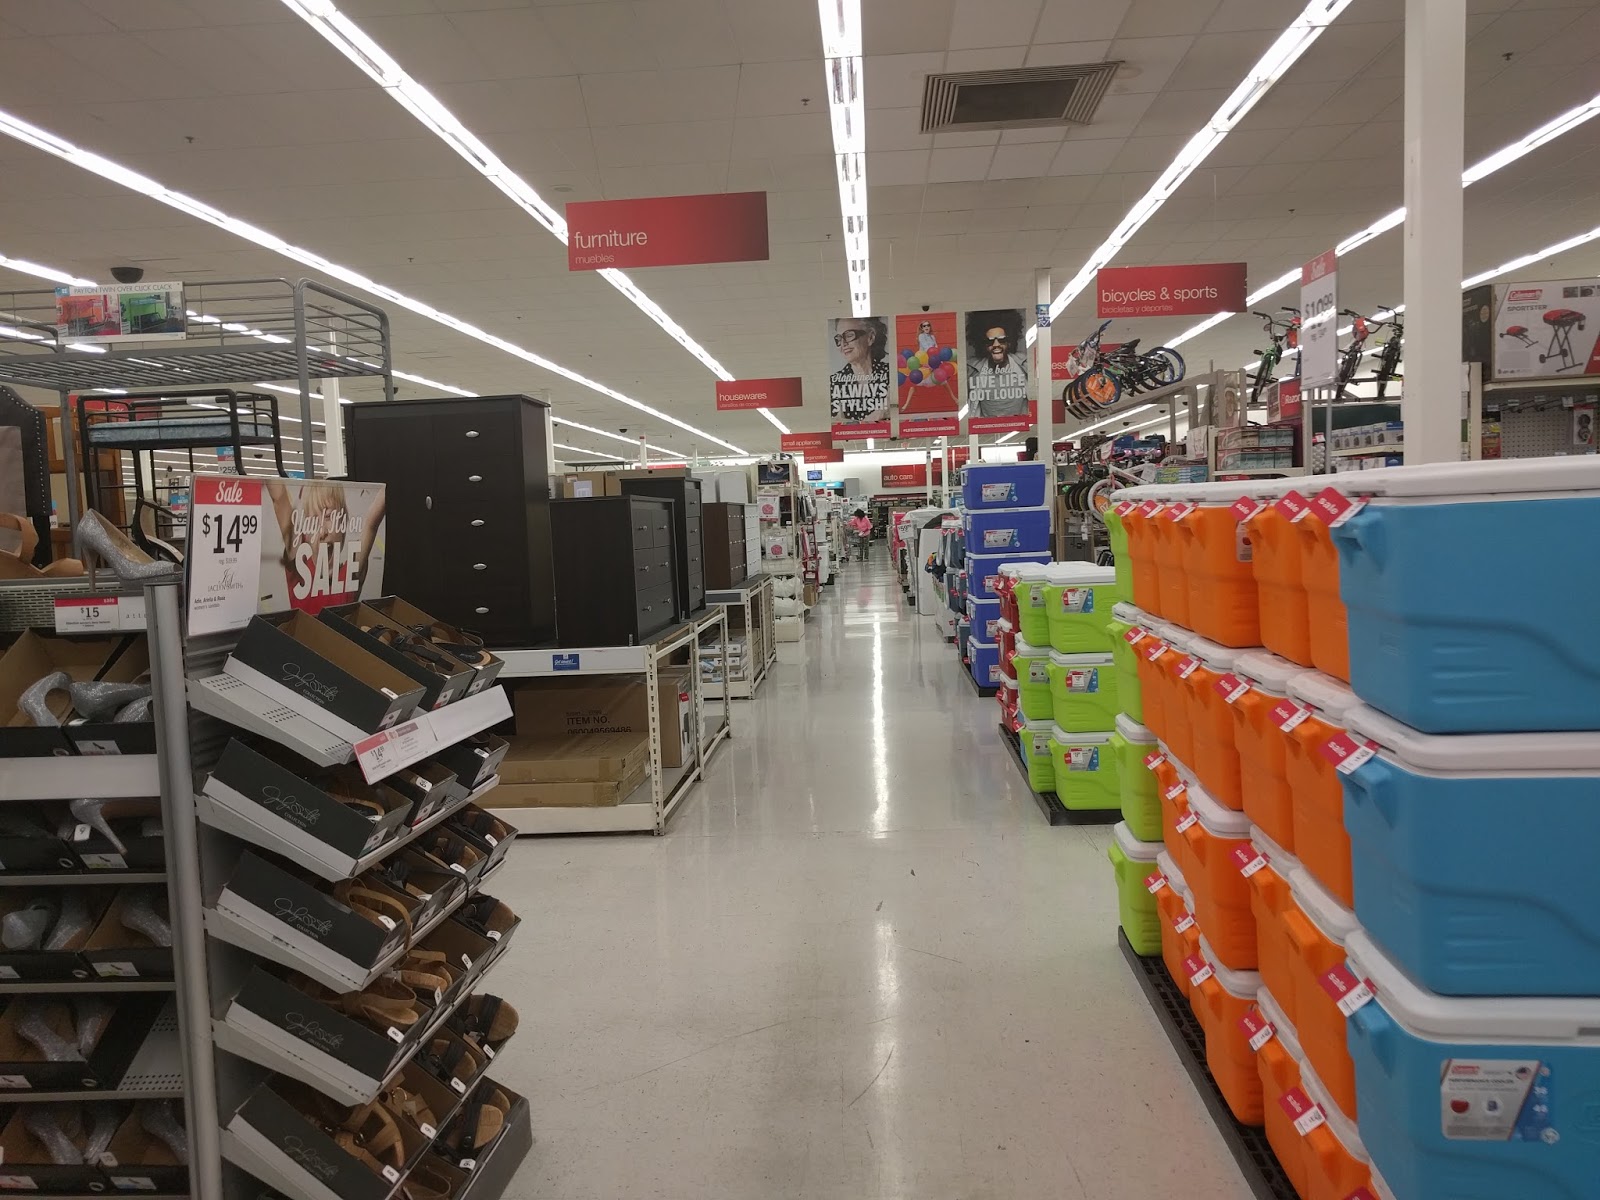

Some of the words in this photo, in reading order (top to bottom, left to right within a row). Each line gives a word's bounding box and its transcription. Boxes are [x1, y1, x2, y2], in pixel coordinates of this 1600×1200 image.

[574, 230, 648, 249] furniture
[575, 253, 615, 264] muebles
[1102, 288, 1156, 305] bicycles
[1159, 287, 1171, 300] &
[1173, 285, 1218, 302] sports
[1101, 305, 1134, 314] bicicletas
[1141, 304, 1173, 313] deportes
[981, 366, 994, 375] Be
[831, 373, 878, 385] Happiness
[879, 372, 888, 381] is
[969, 375, 996, 389] LIVE
[1000, 374, 1026, 387] LIFE
[719, 392, 768, 401] housewares
[832, 383, 888, 399] ALWAYS
[969, 389, 994, 401] OUT
[994, 387, 1027, 400] LOUD!
[832, 398, 888, 413] STYLISH!
[215, 480, 243, 503] Sale
[1282, 499, 1300, 513] sale
[1318, 497, 1338, 515] sale
[291, 508, 326, 548] Yay!
[328, 507, 349, 534] It's
[349, 516, 363, 533] on
[292, 541, 362, 600] SALE
[80, 607, 100, 618] $15
[567, 716, 590, 725] ITEM
[593, 715, 610, 724] NO.
[1274, 707, 1290, 720] sale
[1328, 741, 1347, 758] sale
[1328, 972, 1347, 993] sale
[1243, 1017, 1257, 1032] sale
[1286, 1094, 1302, 1113] sale
